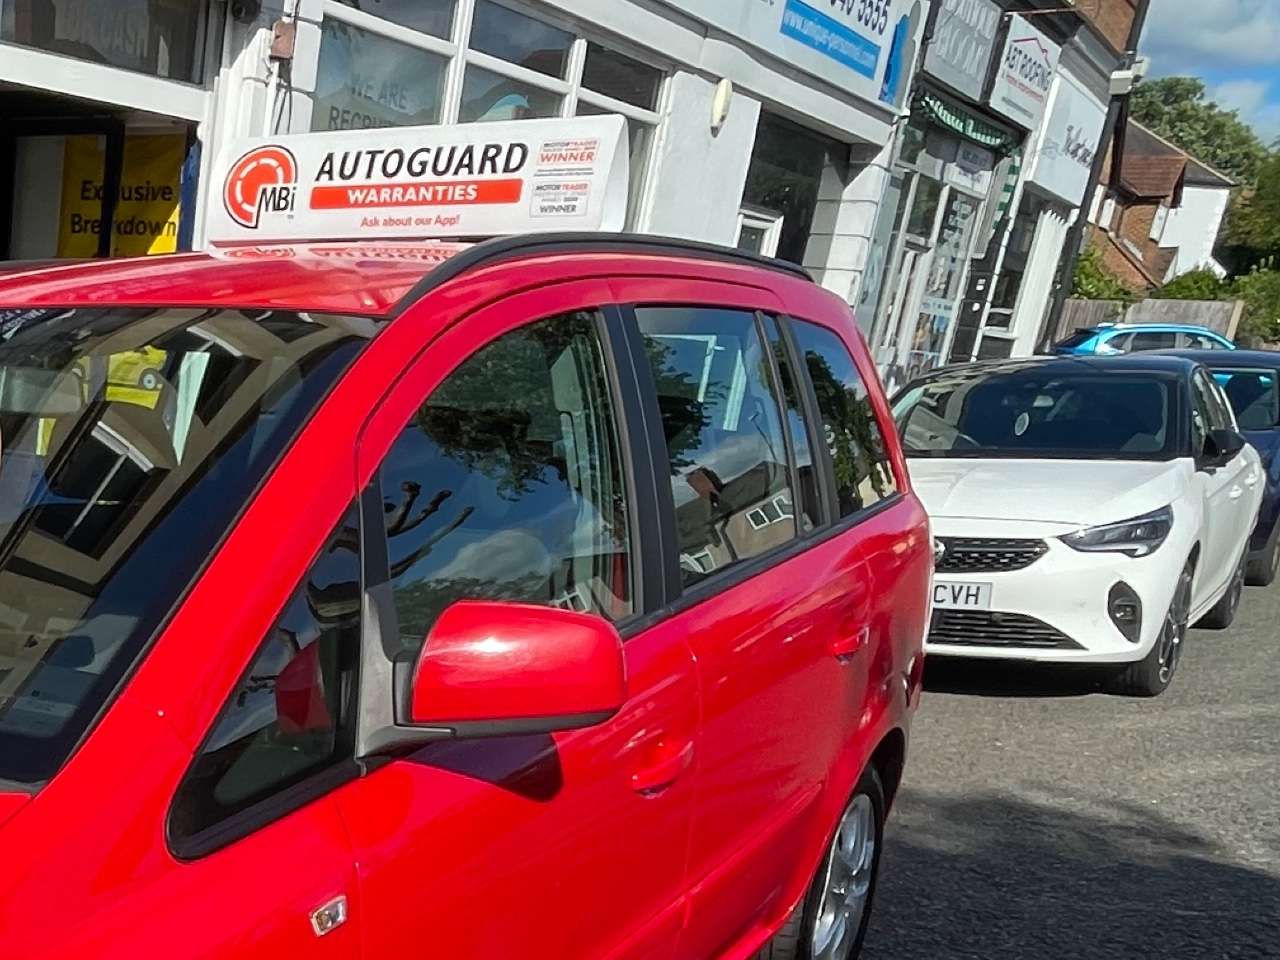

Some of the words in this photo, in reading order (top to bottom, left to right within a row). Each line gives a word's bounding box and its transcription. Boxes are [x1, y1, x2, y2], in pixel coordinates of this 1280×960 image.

[315, 143, 529, 182] AUTOGUARD
[540, 151, 595, 163] WINNER
[80, 180, 174, 201] Exusive
[348, 184, 478, 204] WARRANTIES
[539, 204, 577, 214] WINNER
[70, 213, 177, 237] Bredown
[360, 215, 380, 227] Ask
[382, 214, 412, 226] about
[415, 216, 432, 226] our
[434, 213, 461, 227] App!
[933, 584, 982, 606] CVH
